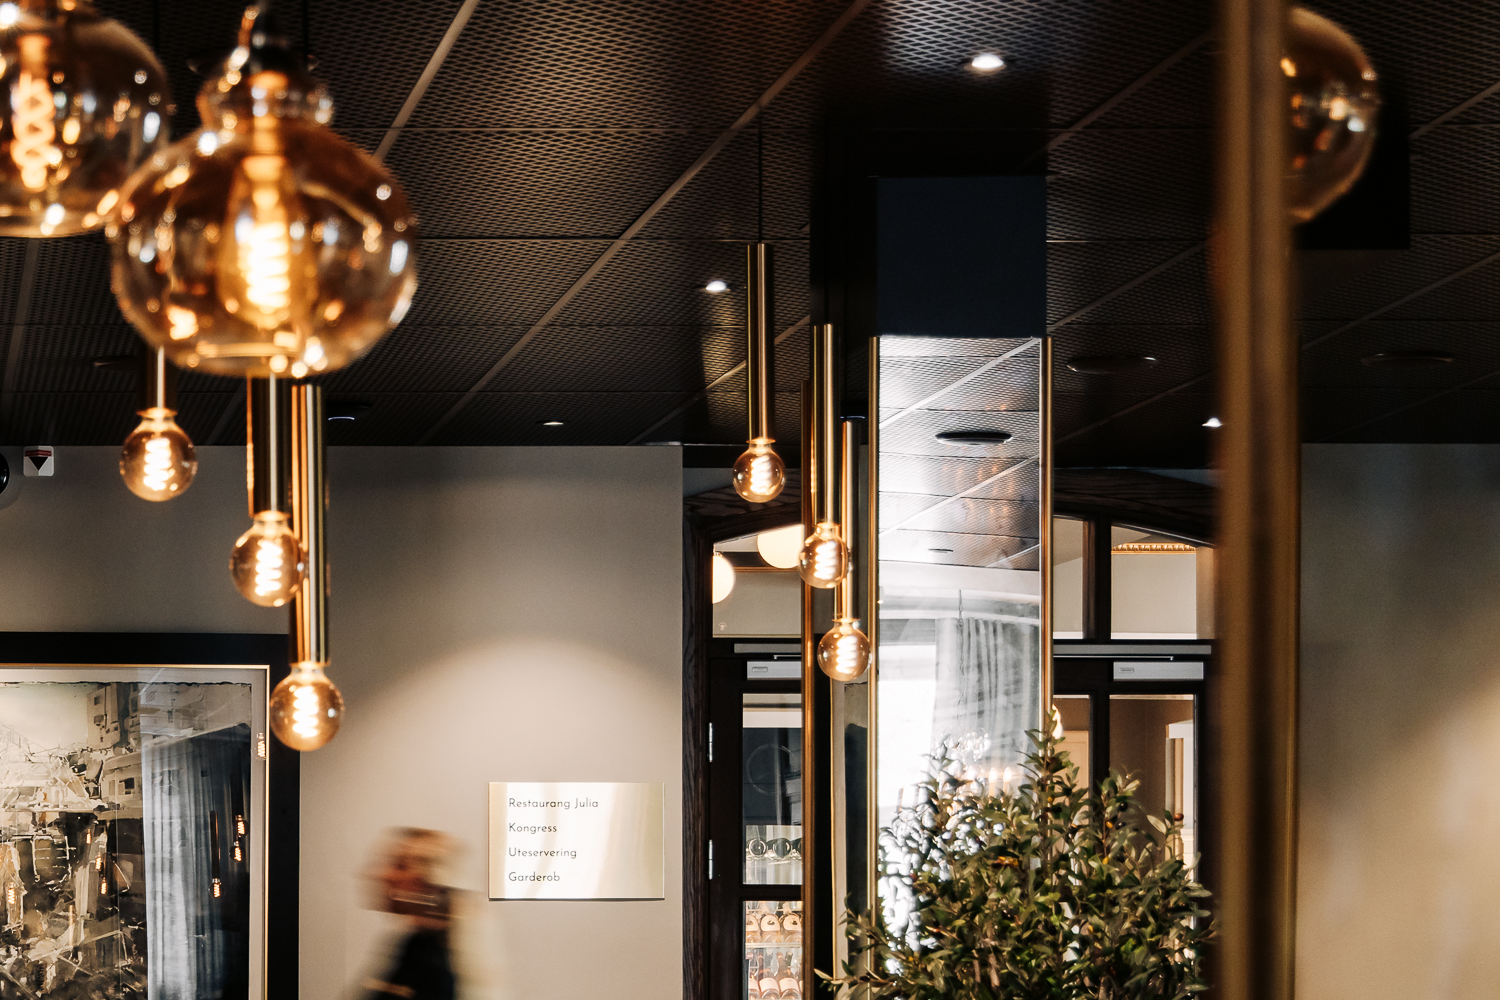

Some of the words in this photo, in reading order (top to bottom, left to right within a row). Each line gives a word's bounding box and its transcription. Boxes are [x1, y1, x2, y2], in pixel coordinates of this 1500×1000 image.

[508, 797, 571, 810] Restaurang
[574, 797, 599, 809] Julia
[508, 822, 558, 834] Kongress
[508, 847, 577, 859] Uteservering
[508, 871, 560, 882] Garderob
